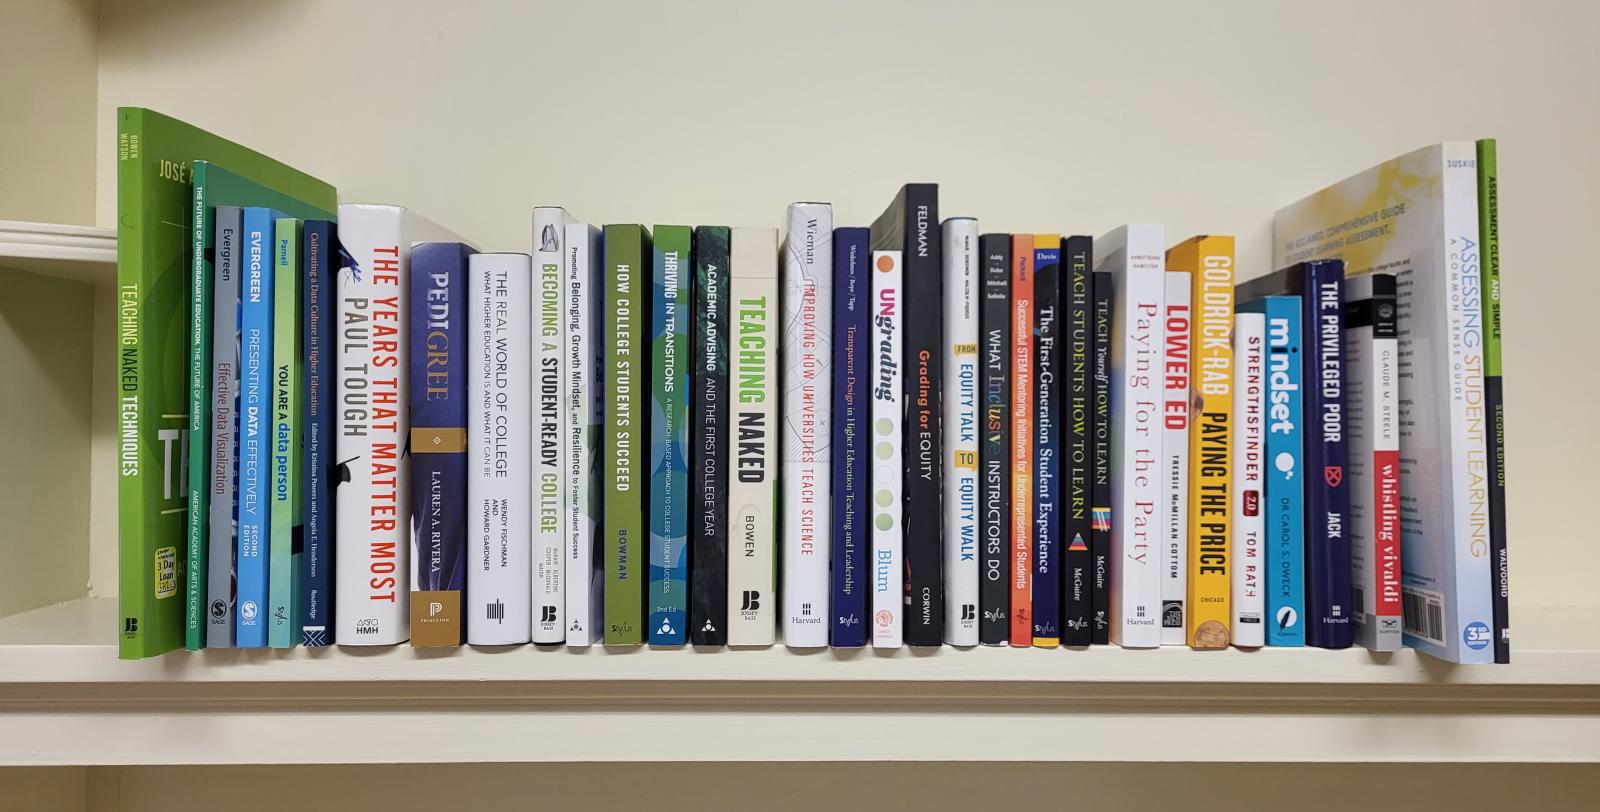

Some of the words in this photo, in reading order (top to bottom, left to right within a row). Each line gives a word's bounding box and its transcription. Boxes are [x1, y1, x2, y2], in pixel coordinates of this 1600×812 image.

[120, 133, 128, 160] WATSON
[1447, 160, 1475, 168] SUSKIE
[918, 206, 928, 256] FELDMAN
[221, 228, 234, 281] Evergreen
[250, 232, 262, 302] EVERGREEN
[310, 232, 318, 278] Cultivating
[372, 246, 398, 286] THE
[664, 250, 678, 298] THRIVING
[542, 264, 558, 336] BECOMING
[706, 264, 717, 320] ACADEMIC
[1073, 252, 1086, 304] TEACH
[1450, 253, 1459, 312] COMMON
[1460, 236, 1480, 348] ASSESSING
[1491, 280, 1500, 300] AND
[122, 283, 138, 345] TEACHING
[310, 304, 318, 333] Culture
[344, 298, 368, 354] PAUL
[372, 296, 398, 368] YEARS
[426, 272, 448, 401] PEDIGREE
[496, 302, 508, 334] REAL
[616, 299, 630, 356] COLLEGE
[1098, 298, 1108, 342] TEACH
[1202, 256, 1232, 396] GOLDRICK-RAB
[1452, 319, 1460, 354] SENSE
[1492, 304, 1500, 340] SIMPLE
[248, 329, 260, 404] PRESENTING
[496, 338, 508, 388] WORLD
[542, 342, 557, 352] A
[572, 335, 580, 368] Growth
[665, 316, 675, 392] TRANSITIONS
[706, 321, 716, 372] ADVISING
[738, 296, 766, 403] TEACHING
[803, 354, 814, 380] HOW
[875, 289, 898, 402] UNgrading
[988, 330, 1001, 370] WHAT
[1017, 346, 1028, 372] STEM
[1072, 310, 1086, 392] STUDENTS
[1130, 302, 1157, 389] Paying
[1166, 305, 1188, 390] LOWER
[1322, 315, 1340, 398] PRIVILEGED
[122, 348, 138, 392] NAKED
[918, 350, 930, 406] Grading
[958, 364, 974, 408] EQUITY
[1040, 338, 1054, 444] First-Generation
[1270, 318, 1298, 434] mindset
[1382, 350, 1390, 388] CLAUDE
[1454, 364, 1462, 400] GUIDE
[278, 412, 288, 420] A
[310, 375, 318, 416] Education
[344, 364, 368, 436] TOUGH
[372, 378, 398, 432] THAT
[616, 361, 630, 426] STUDENTS
[1165, 400, 1187, 430] ED
[1246, 336, 1260, 481] STRENGTHSFINDER
[1464, 354, 1483, 443] STUDENT
[122, 395, 138, 476] TECHNIQUES
[248, 406, 258, 437] DATA
[278, 422, 290, 452] data
[705, 427, 716, 456] FIRST
[960, 412, 974, 442] TALK
[1323, 404, 1341, 442] POOR
[1496, 404, 1504, 444] SECOND
[216, 434, 229, 495] Visualization
[496, 416, 508, 478] COLLEGE
[616, 432, 630, 491] SUCCEED
[738, 412, 766, 482] NAKED
[920, 432, 932, 480] EQUITY
[960, 454, 974, 464] TO
[1096, 442, 1108, 485] LEARN
[1201, 412, 1228, 477] PAYING
[1496, 446, 1504, 487] EDITION
[246, 440, 258, 515] EFFECTIVELY
[370, 444, 397, 531] MATTER
[704, 458, 714, 507] COLLEGE
[846, 450, 855, 491] Education
[1040, 448, 1053, 498] Student
[1172, 455, 1180, 490] TRESSIE
[192, 490, 200, 524] AMERICAN
[432, 472, 441, 516] LAUREN
[541, 473, 558, 533] COLLEGE
[958, 478, 974, 521] EQUITY
[988, 460, 1000, 554] INSTRUCTORS
[1170, 494, 1180, 539] McMILLAN
[1200, 484, 1226, 516] THE
[1280, 498, 1290, 510] DR
[1380, 464, 1397, 540] whistling
[1467, 450, 1488, 557] LEARNING
[251, 525, 259, 557] SECOND
[432, 518, 440, 528] A.
[745, 515, 754, 557] BOWEN
[802, 510, 813, 556] SCIENCE
[846, 531, 854, 548] and
[960, 525, 974, 562] WALK
[1036, 502, 1052, 574] Experience
[1128, 500, 1154, 565] Party
[1246, 532, 1256, 558] TOM
[1282, 514, 1290, 546] CAROL
[1328, 512, 1342, 538] JACK
[432, 531, 440, 572] RIVERA
[618, 530, 626, 580] BOWMAN
[878, 549, 892, 592] Blum
[1096, 556, 1106, 588] McGuire
[1170, 544, 1178, 578] COTTOM
[1200, 524, 1226, 576] PRICE
[1074, 568, 1082, 601] McGuire
[1245, 565, 1256, 598] RATH
[1282, 562, 1290, 598] DWECK
[1384, 546, 1398, 602] vivaldi
[309, 590, 318, 620] Routledge
[922, 588, 931, 625] CORWIN
